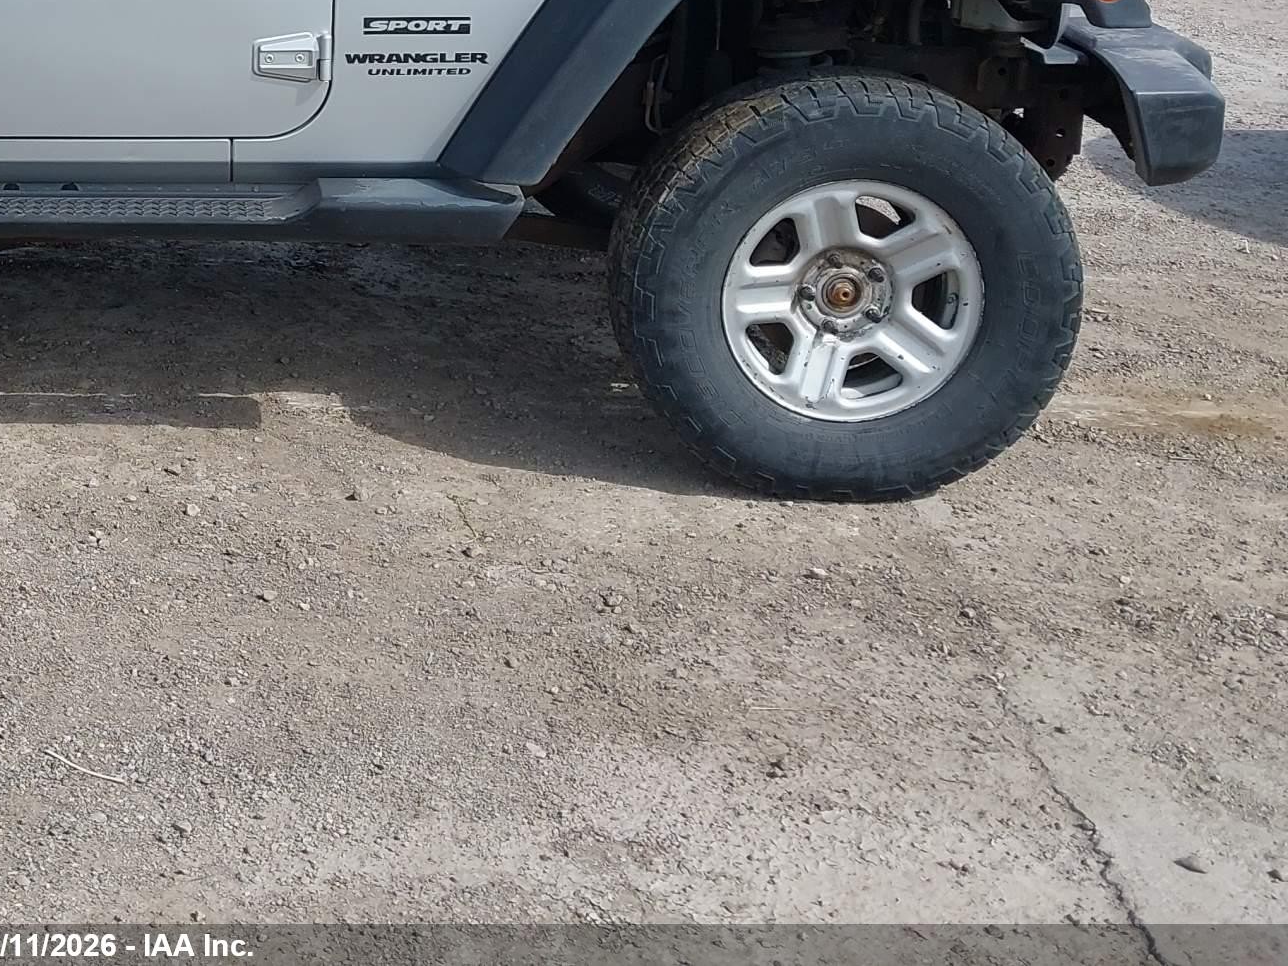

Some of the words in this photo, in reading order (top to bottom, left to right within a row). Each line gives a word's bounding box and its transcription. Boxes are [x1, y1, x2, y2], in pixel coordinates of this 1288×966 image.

[364, 18, 470, 33] SPORT
[345, 52, 489, 64] WRANGLER
[368, 67, 472, 76] UNLIMITED
